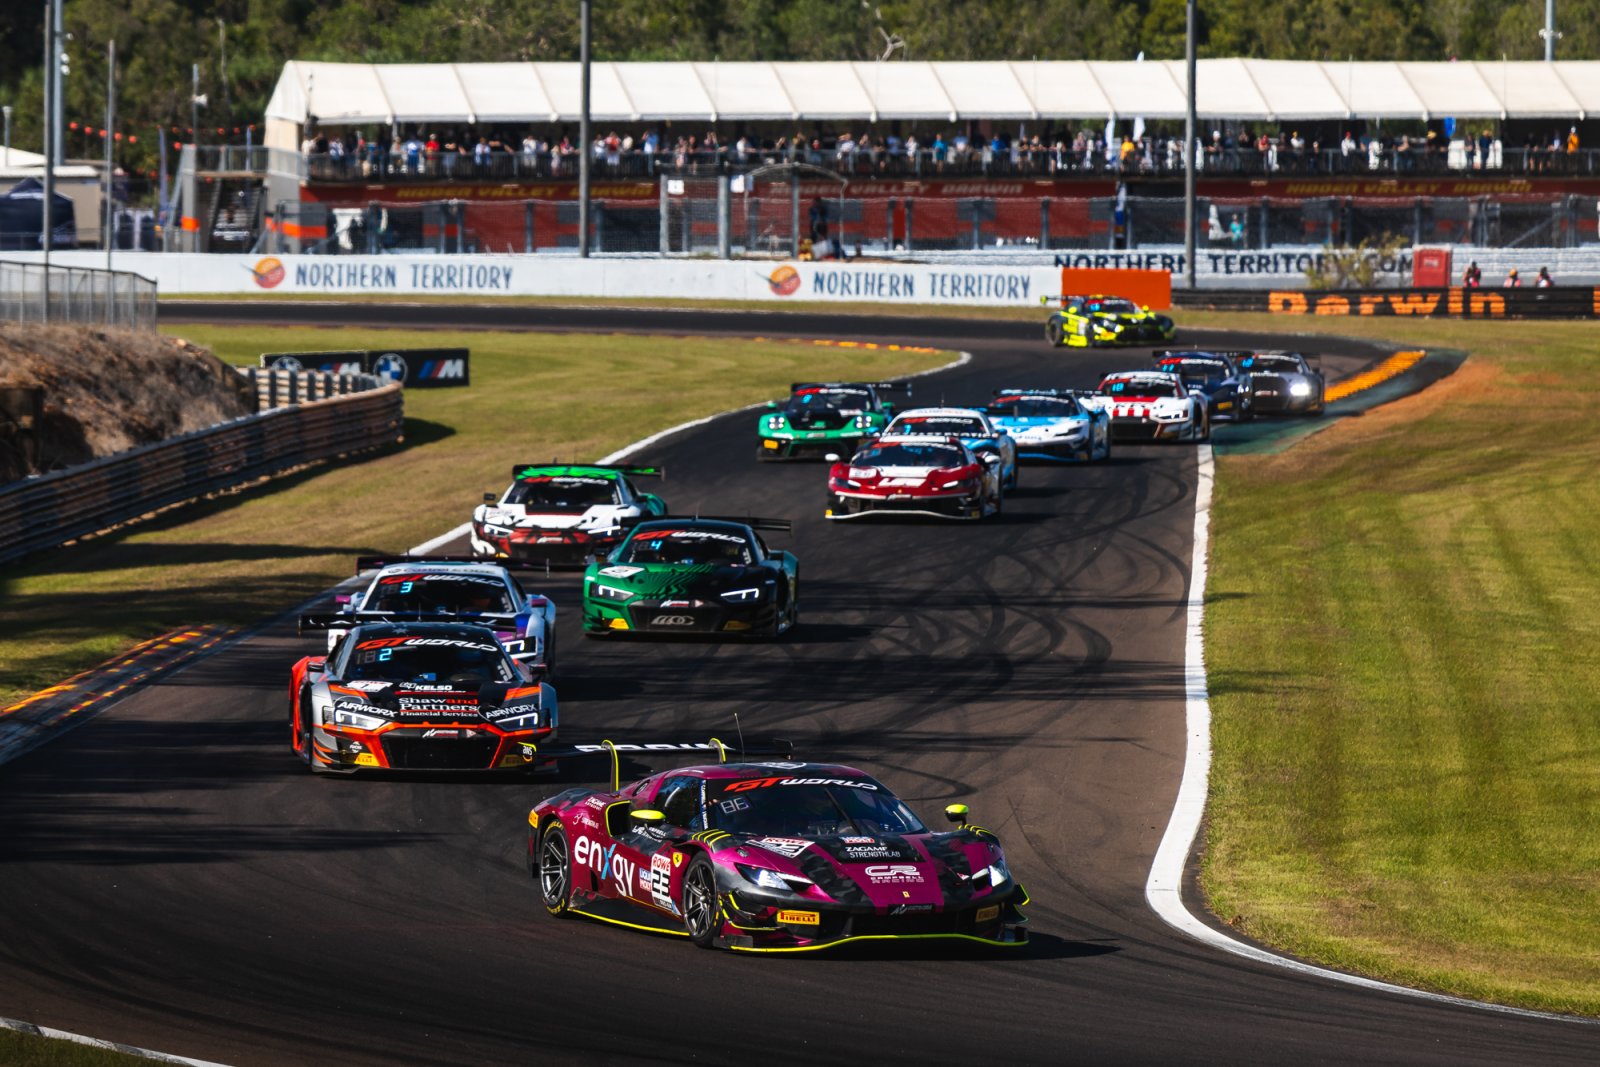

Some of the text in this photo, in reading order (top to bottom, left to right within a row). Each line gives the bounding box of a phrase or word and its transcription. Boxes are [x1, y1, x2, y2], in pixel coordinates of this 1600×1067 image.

[296, 263, 513, 289] NORTHERN TERRITORY
[813, 271, 1031, 299] NORTHERN TERRITORY
[1268, 288, 1506, 316] Darwin
[651, 540, 663, 550] 4
[400, 581, 413, 593] 3
[379, 648, 392, 661] 2
[399, 697, 446, 705] Shaw
[400, 703, 478, 711] Partners
[337, 701, 399, 718] AIRWORX
[486, 703, 538, 719] AIRWORX
[652, 856, 670, 873] ROWE
[865, 865, 921, 877] CR
[652, 869, 670, 897] 23
[780, 911, 818, 922] PIRELLI
